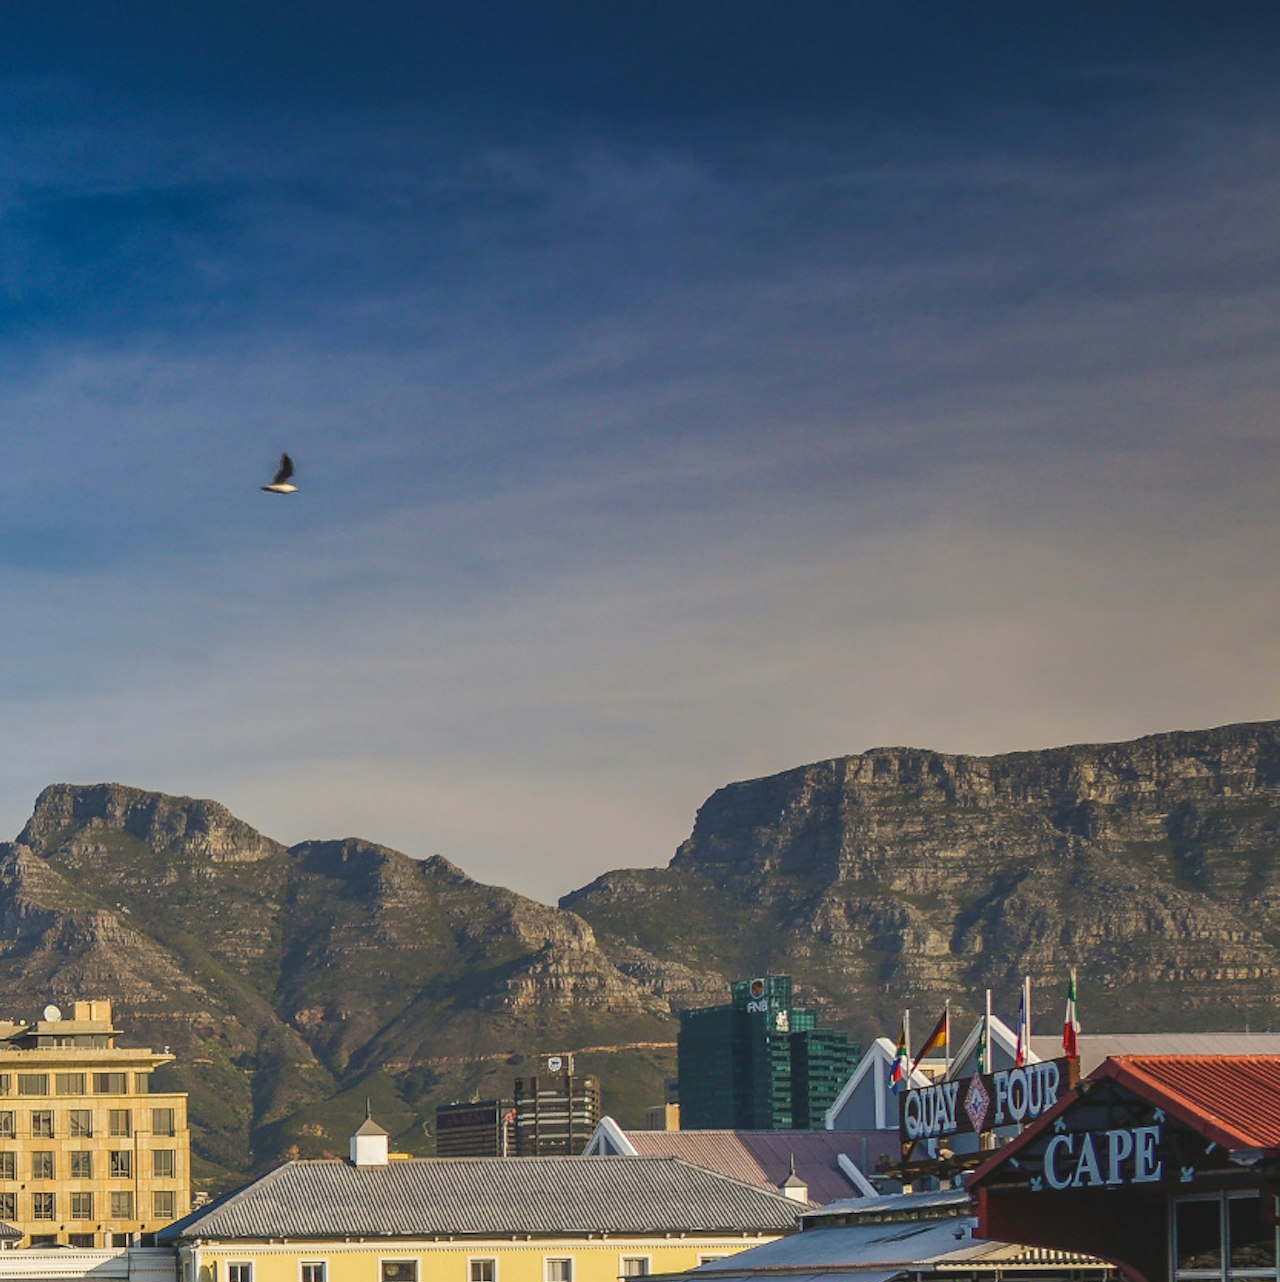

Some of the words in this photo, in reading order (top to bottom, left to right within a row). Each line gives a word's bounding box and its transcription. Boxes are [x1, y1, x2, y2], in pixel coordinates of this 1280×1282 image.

[747, 1000, 768, 1013] FNB
[904, 1081, 959, 1139] QUAY
[994, 1061, 1061, 1124] FOUR
[1044, 1126, 1162, 1189] CAPE
